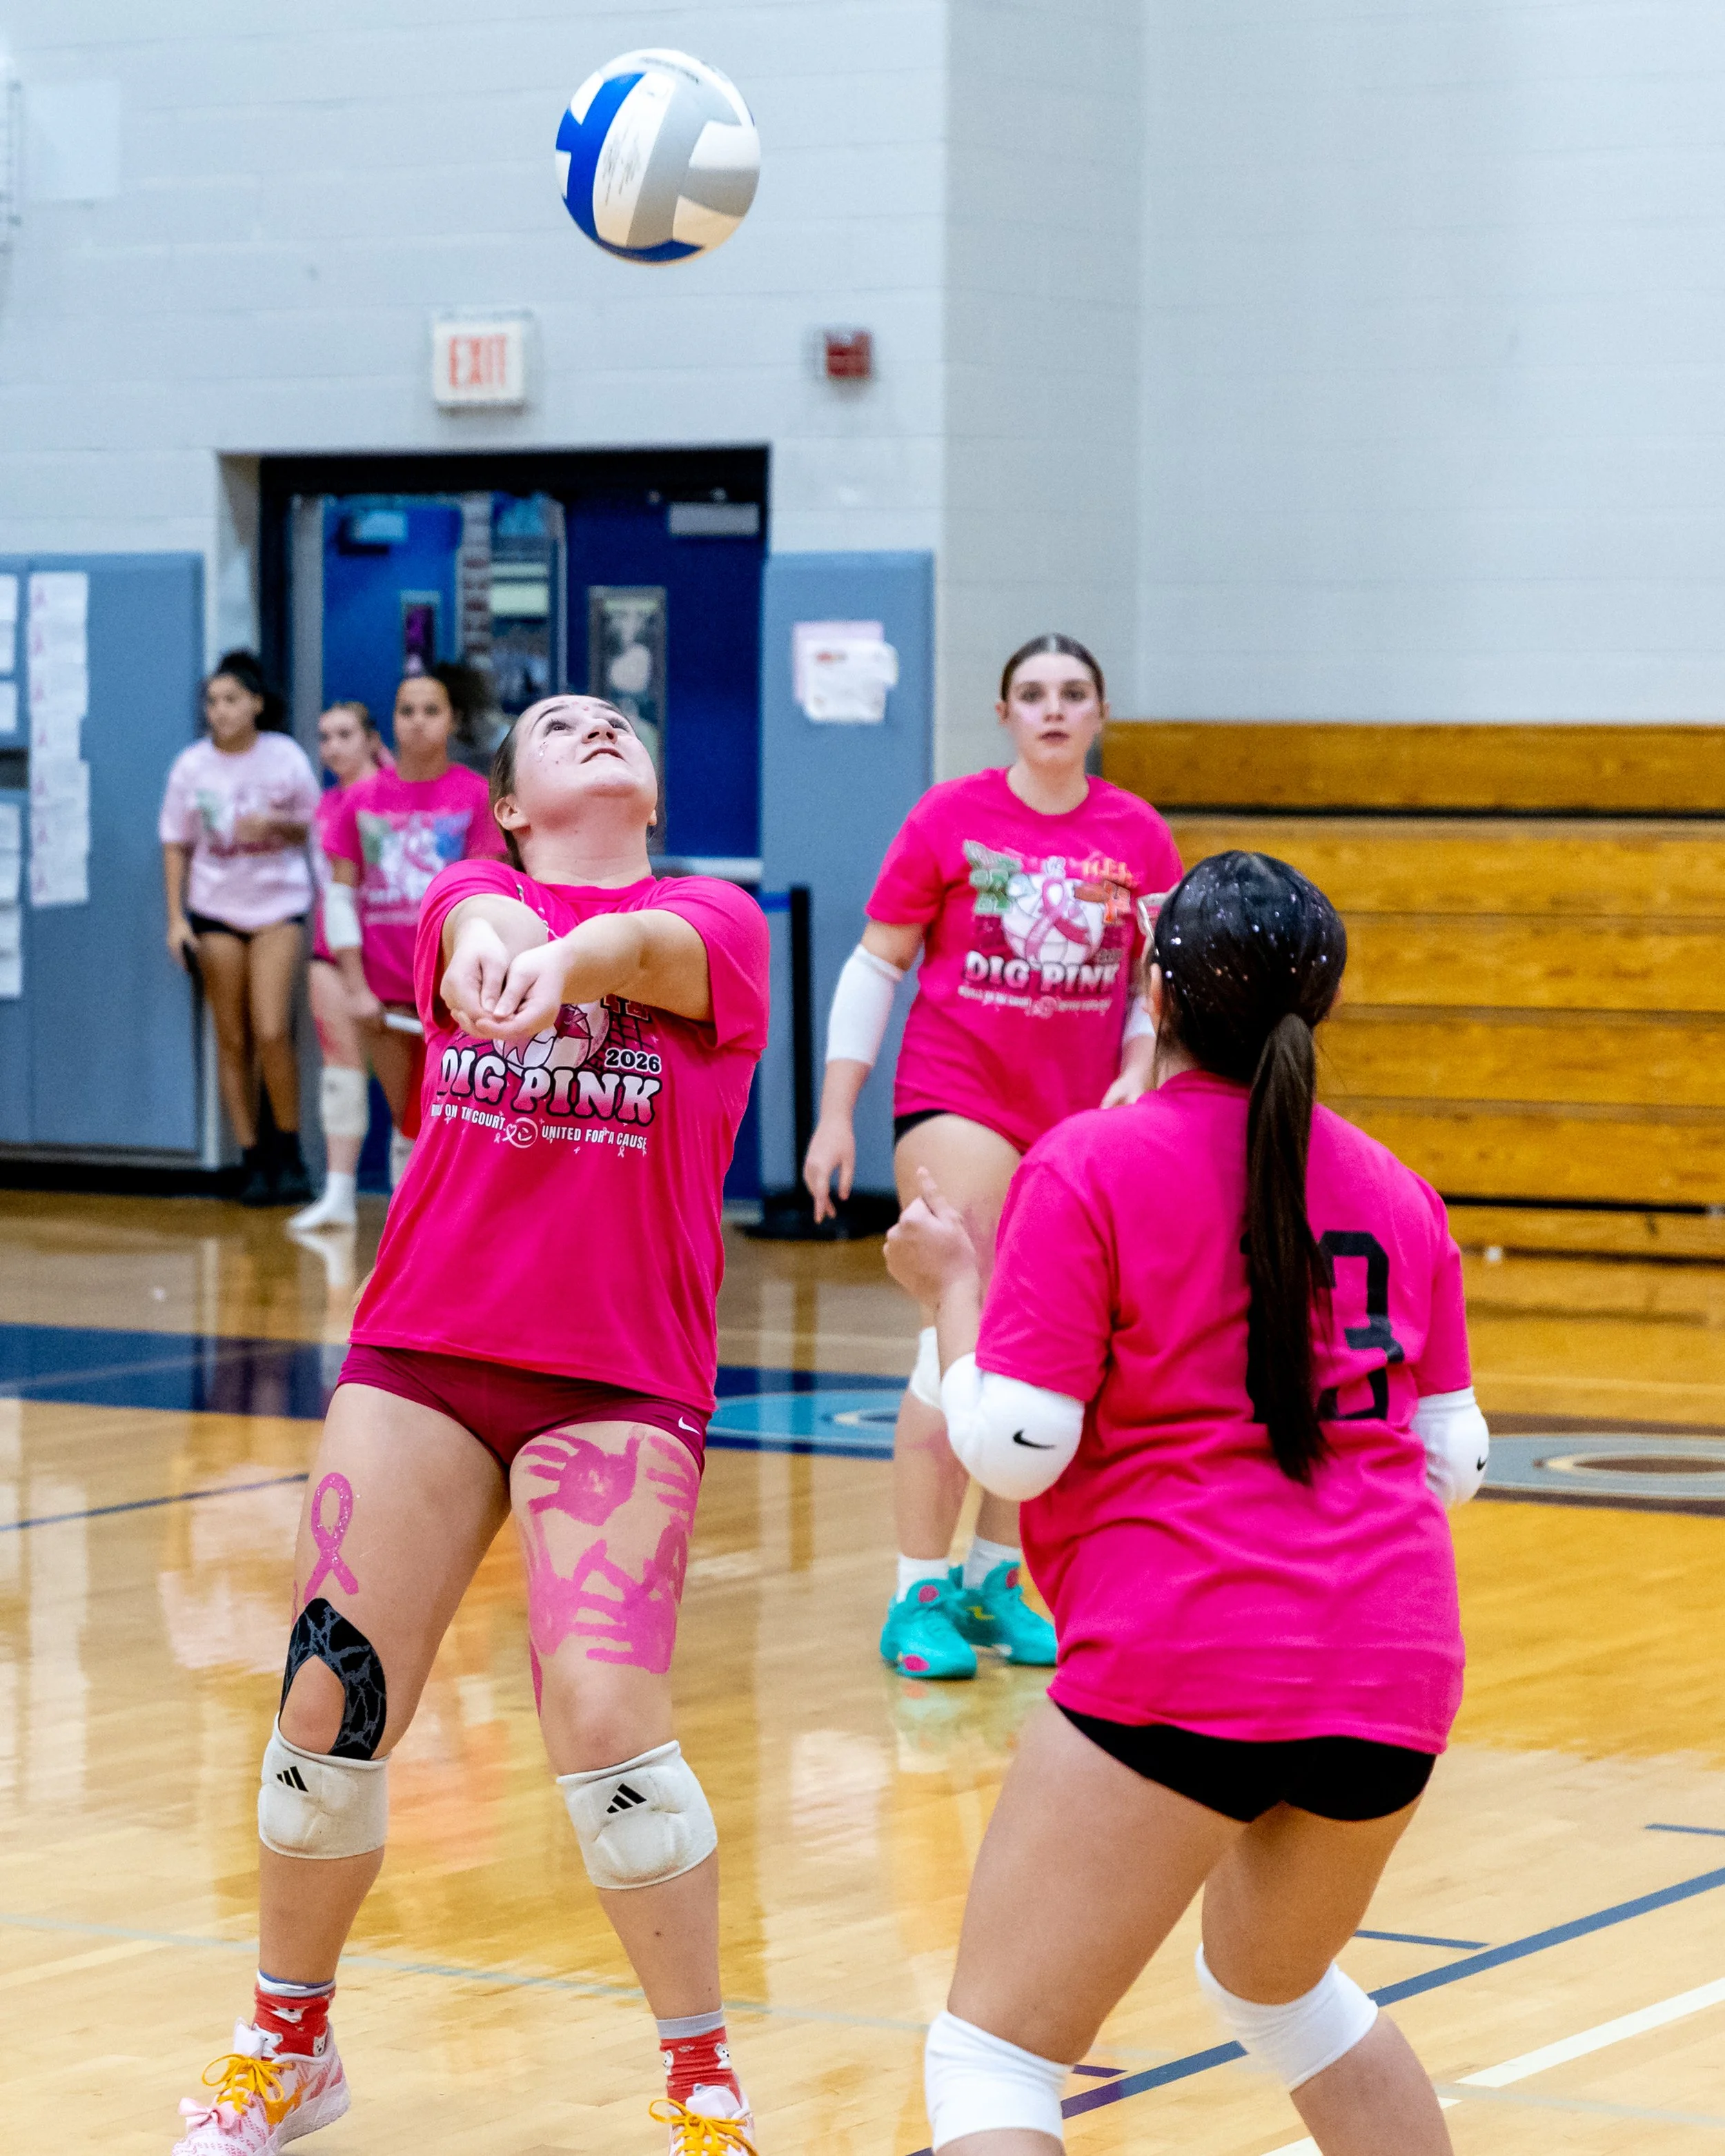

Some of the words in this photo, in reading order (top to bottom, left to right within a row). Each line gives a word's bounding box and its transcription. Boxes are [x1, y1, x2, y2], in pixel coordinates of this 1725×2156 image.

[448, 334, 506, 388] EXIT
[964, 950, 1030, 989] DIG
[605, 1047, 662, 1075] 2026
[438, 1046, 508, 1105] DIG
[513, 1066, 662, 1127] PINK
[445, 1104, 458, 1118] ON
[542, 1125, 582, 1141] UNITED
[585, 1129, 604, 1143] FOR
[607, 1131, 615, 1145] A
[616, 1132, 647, 1150] CAUSE
